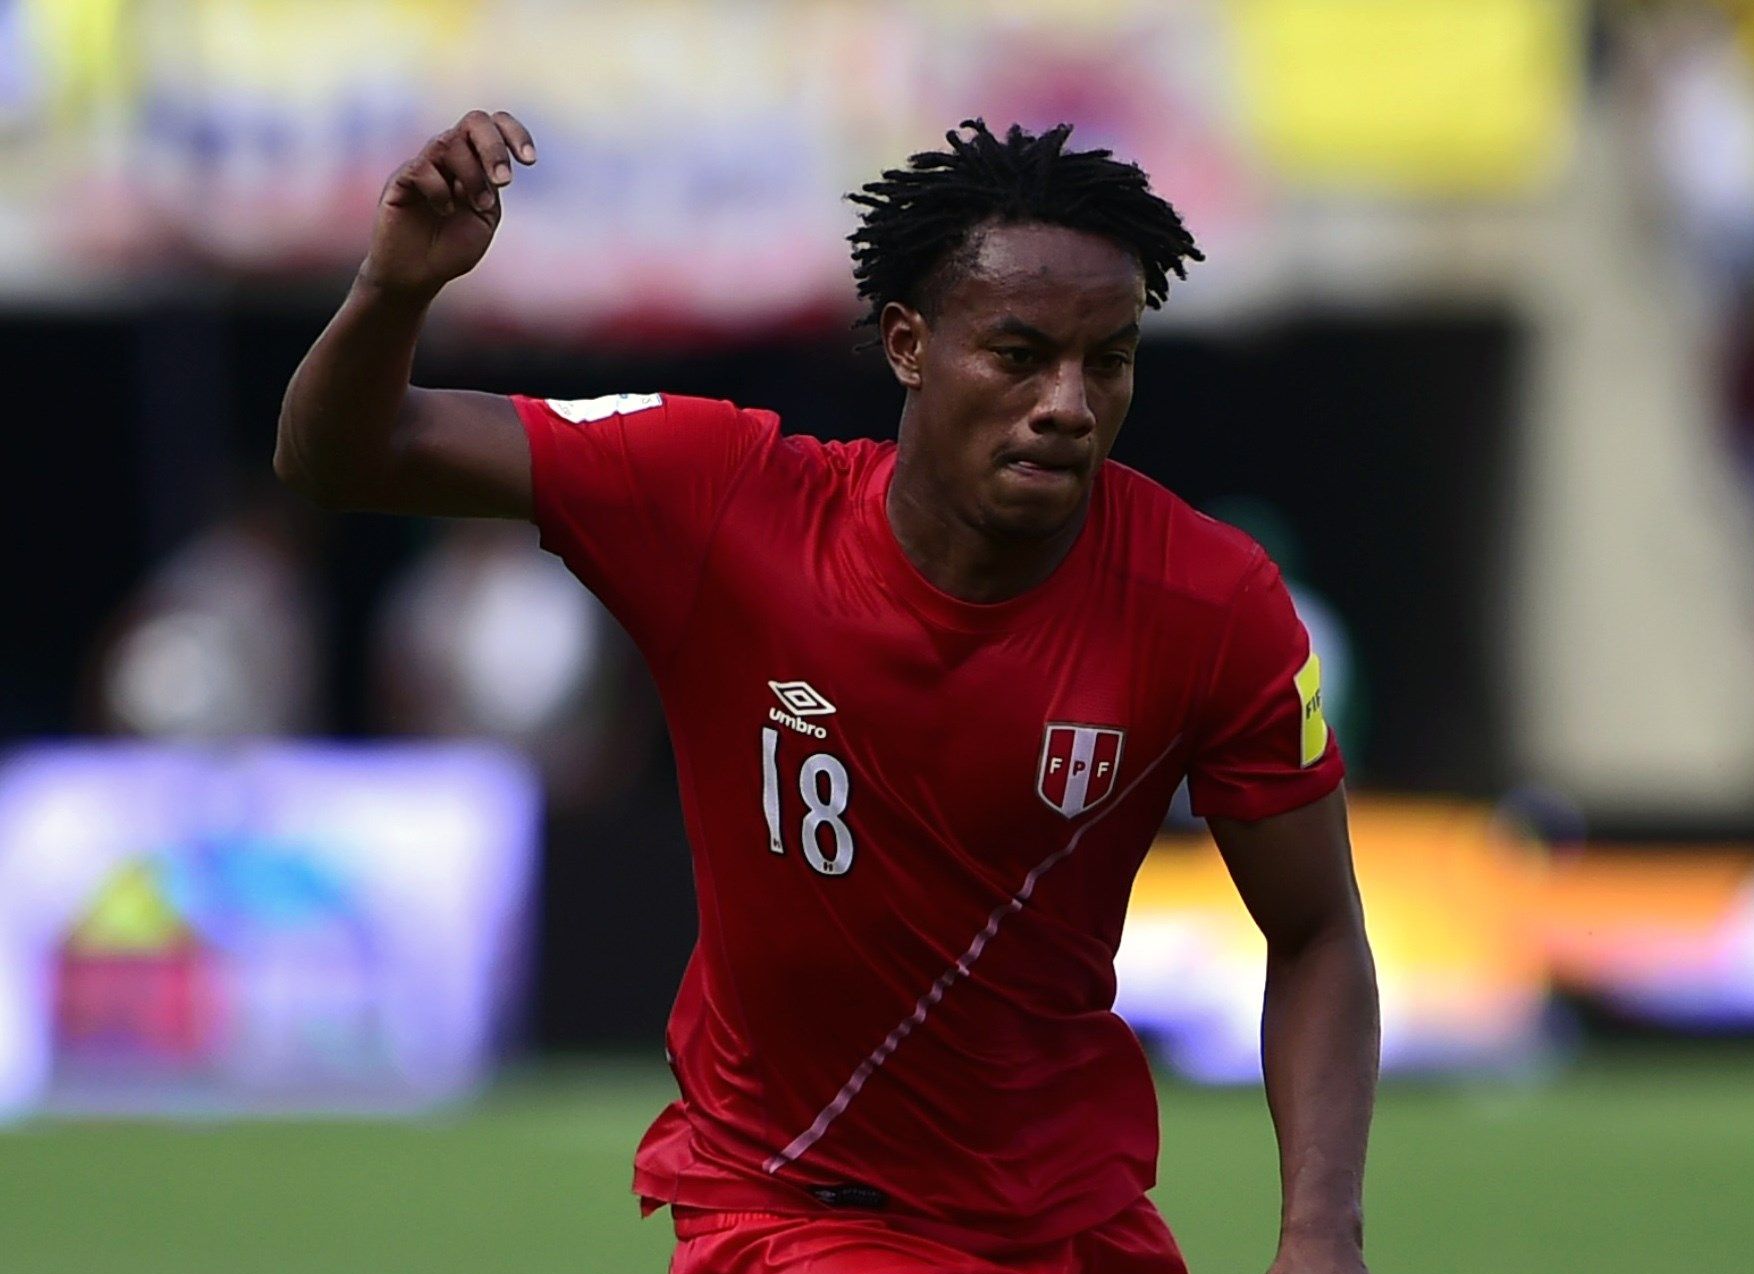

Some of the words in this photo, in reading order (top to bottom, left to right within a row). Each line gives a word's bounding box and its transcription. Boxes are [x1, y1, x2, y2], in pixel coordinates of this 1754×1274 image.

[1305, 687, 1321, 720] FIF
[768, 707, 828, 739] umbro
[762, 726, 855, 876] 18
